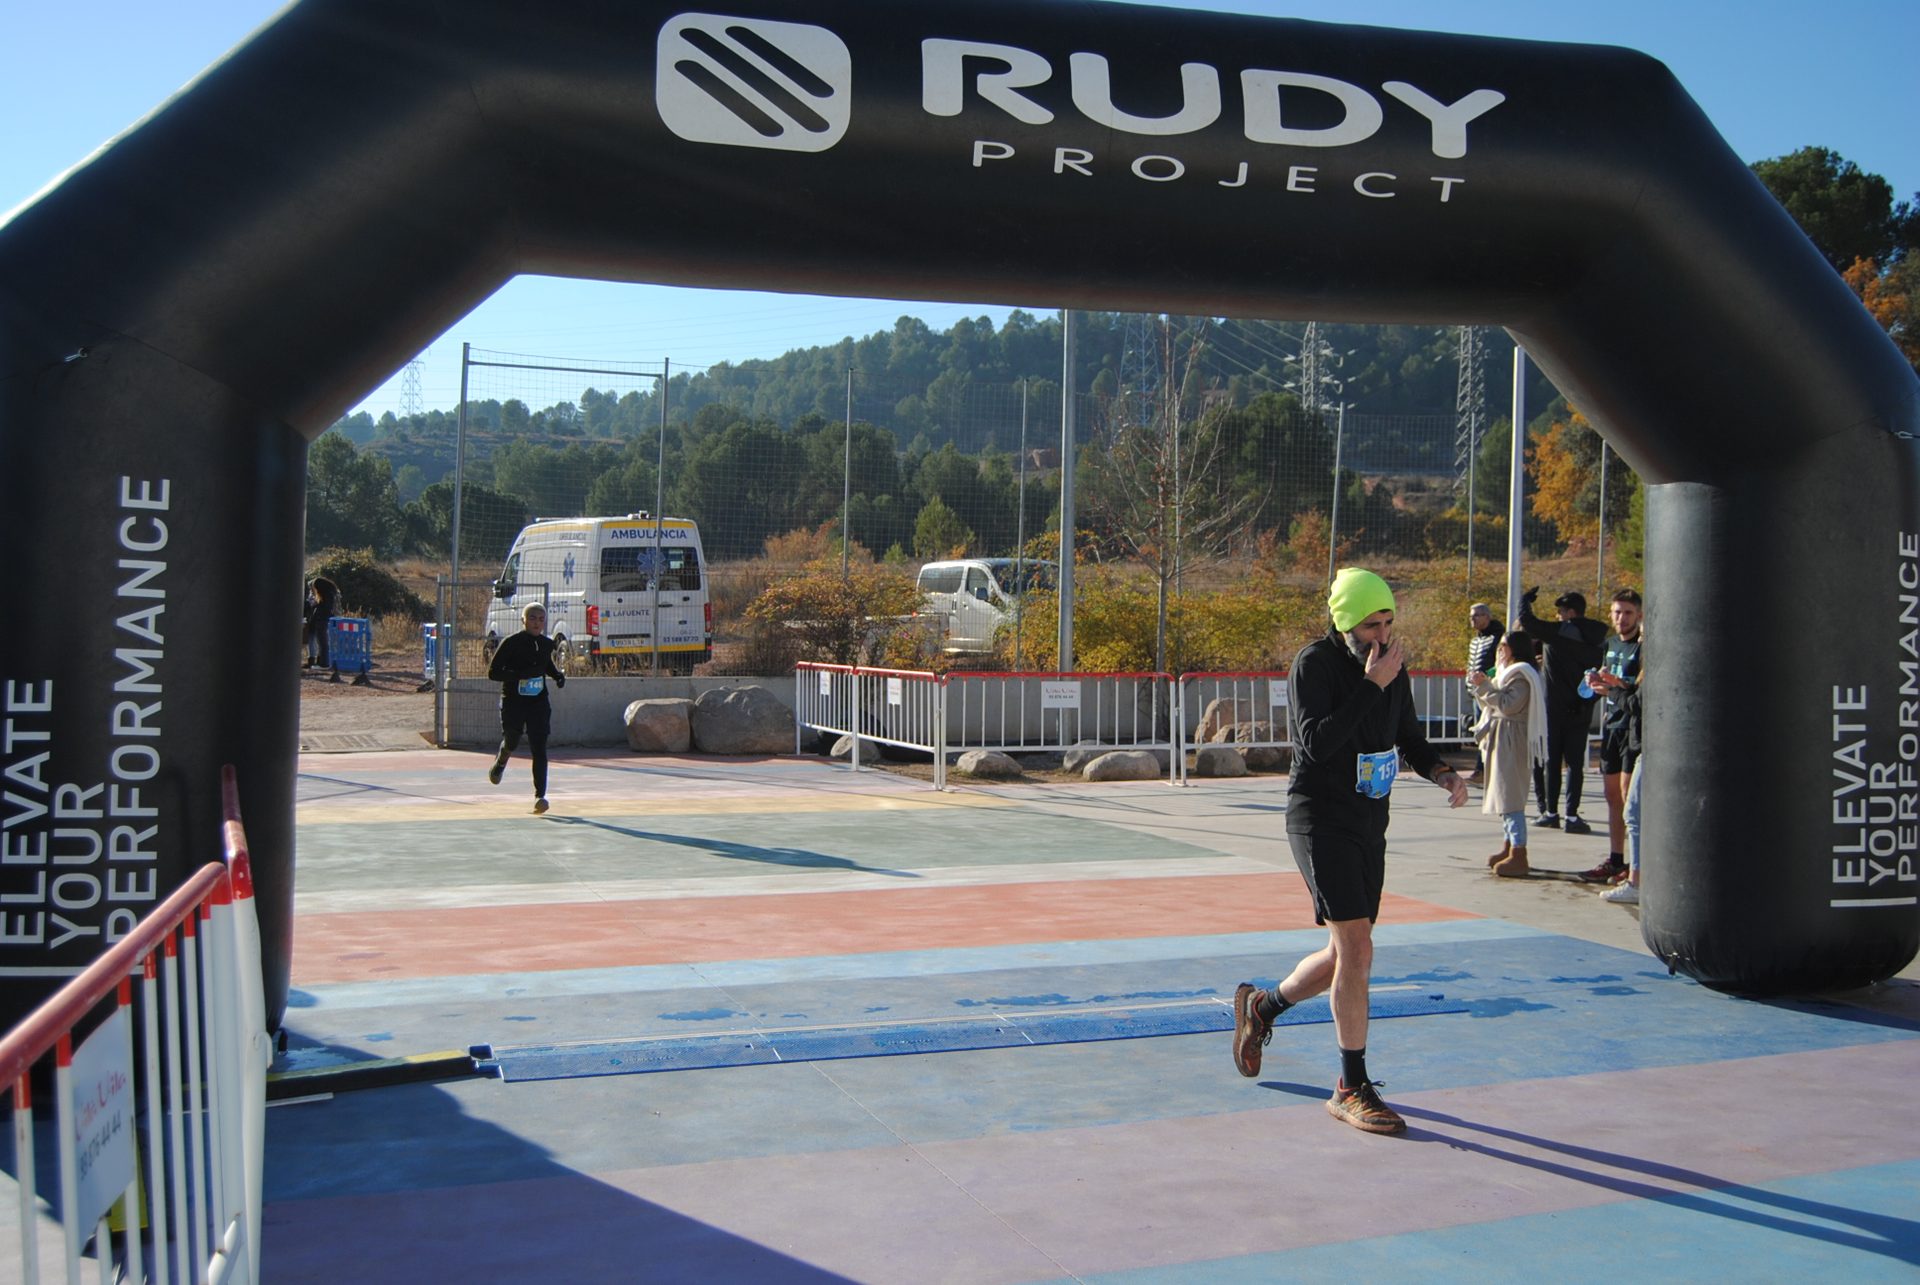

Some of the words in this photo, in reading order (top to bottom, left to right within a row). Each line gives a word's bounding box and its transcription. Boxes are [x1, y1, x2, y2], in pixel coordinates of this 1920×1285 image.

[921, 38, 1505, 159] RUDY
[972, 140, 1465, 203] PROJECT
[107, 475, 170, 945] PERFORMANCE
[1833, 685, 1866, 883] ELEVATE
[1898, 531, 1919, 882] PERFORMANCE
[0, 680, 53, 945] ELEVATE
[50, 781, 104, 950] YOUR
[1869, 761, 1897, 886] YOUR
